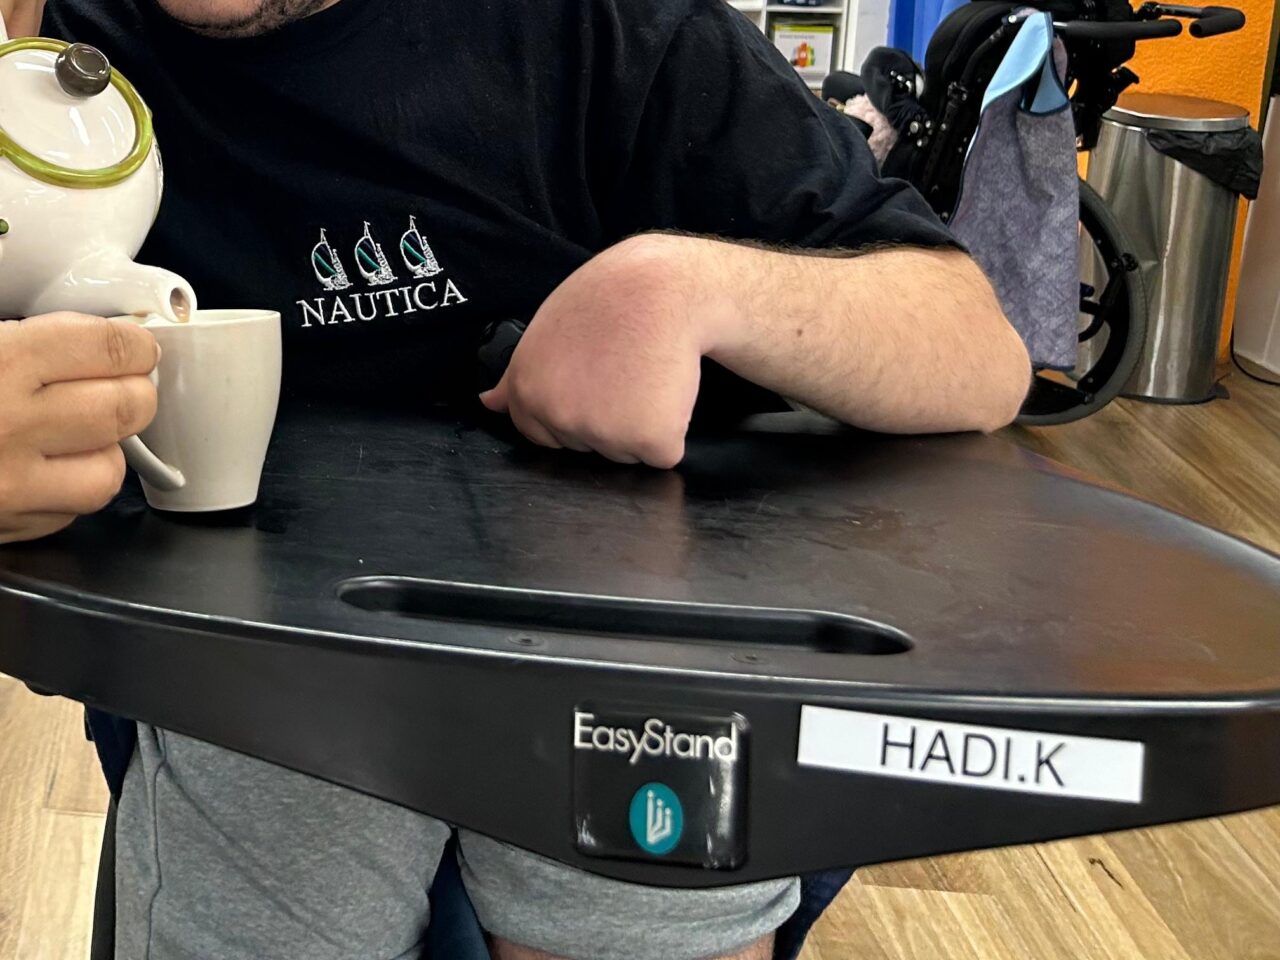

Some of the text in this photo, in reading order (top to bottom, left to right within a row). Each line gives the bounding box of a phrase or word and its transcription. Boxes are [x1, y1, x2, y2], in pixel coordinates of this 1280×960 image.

[296, 278, 468, 327] NAUTICA
[573, 711, 738, 765] EasyStand
[879, 722, 1067, 787] HADI.K
